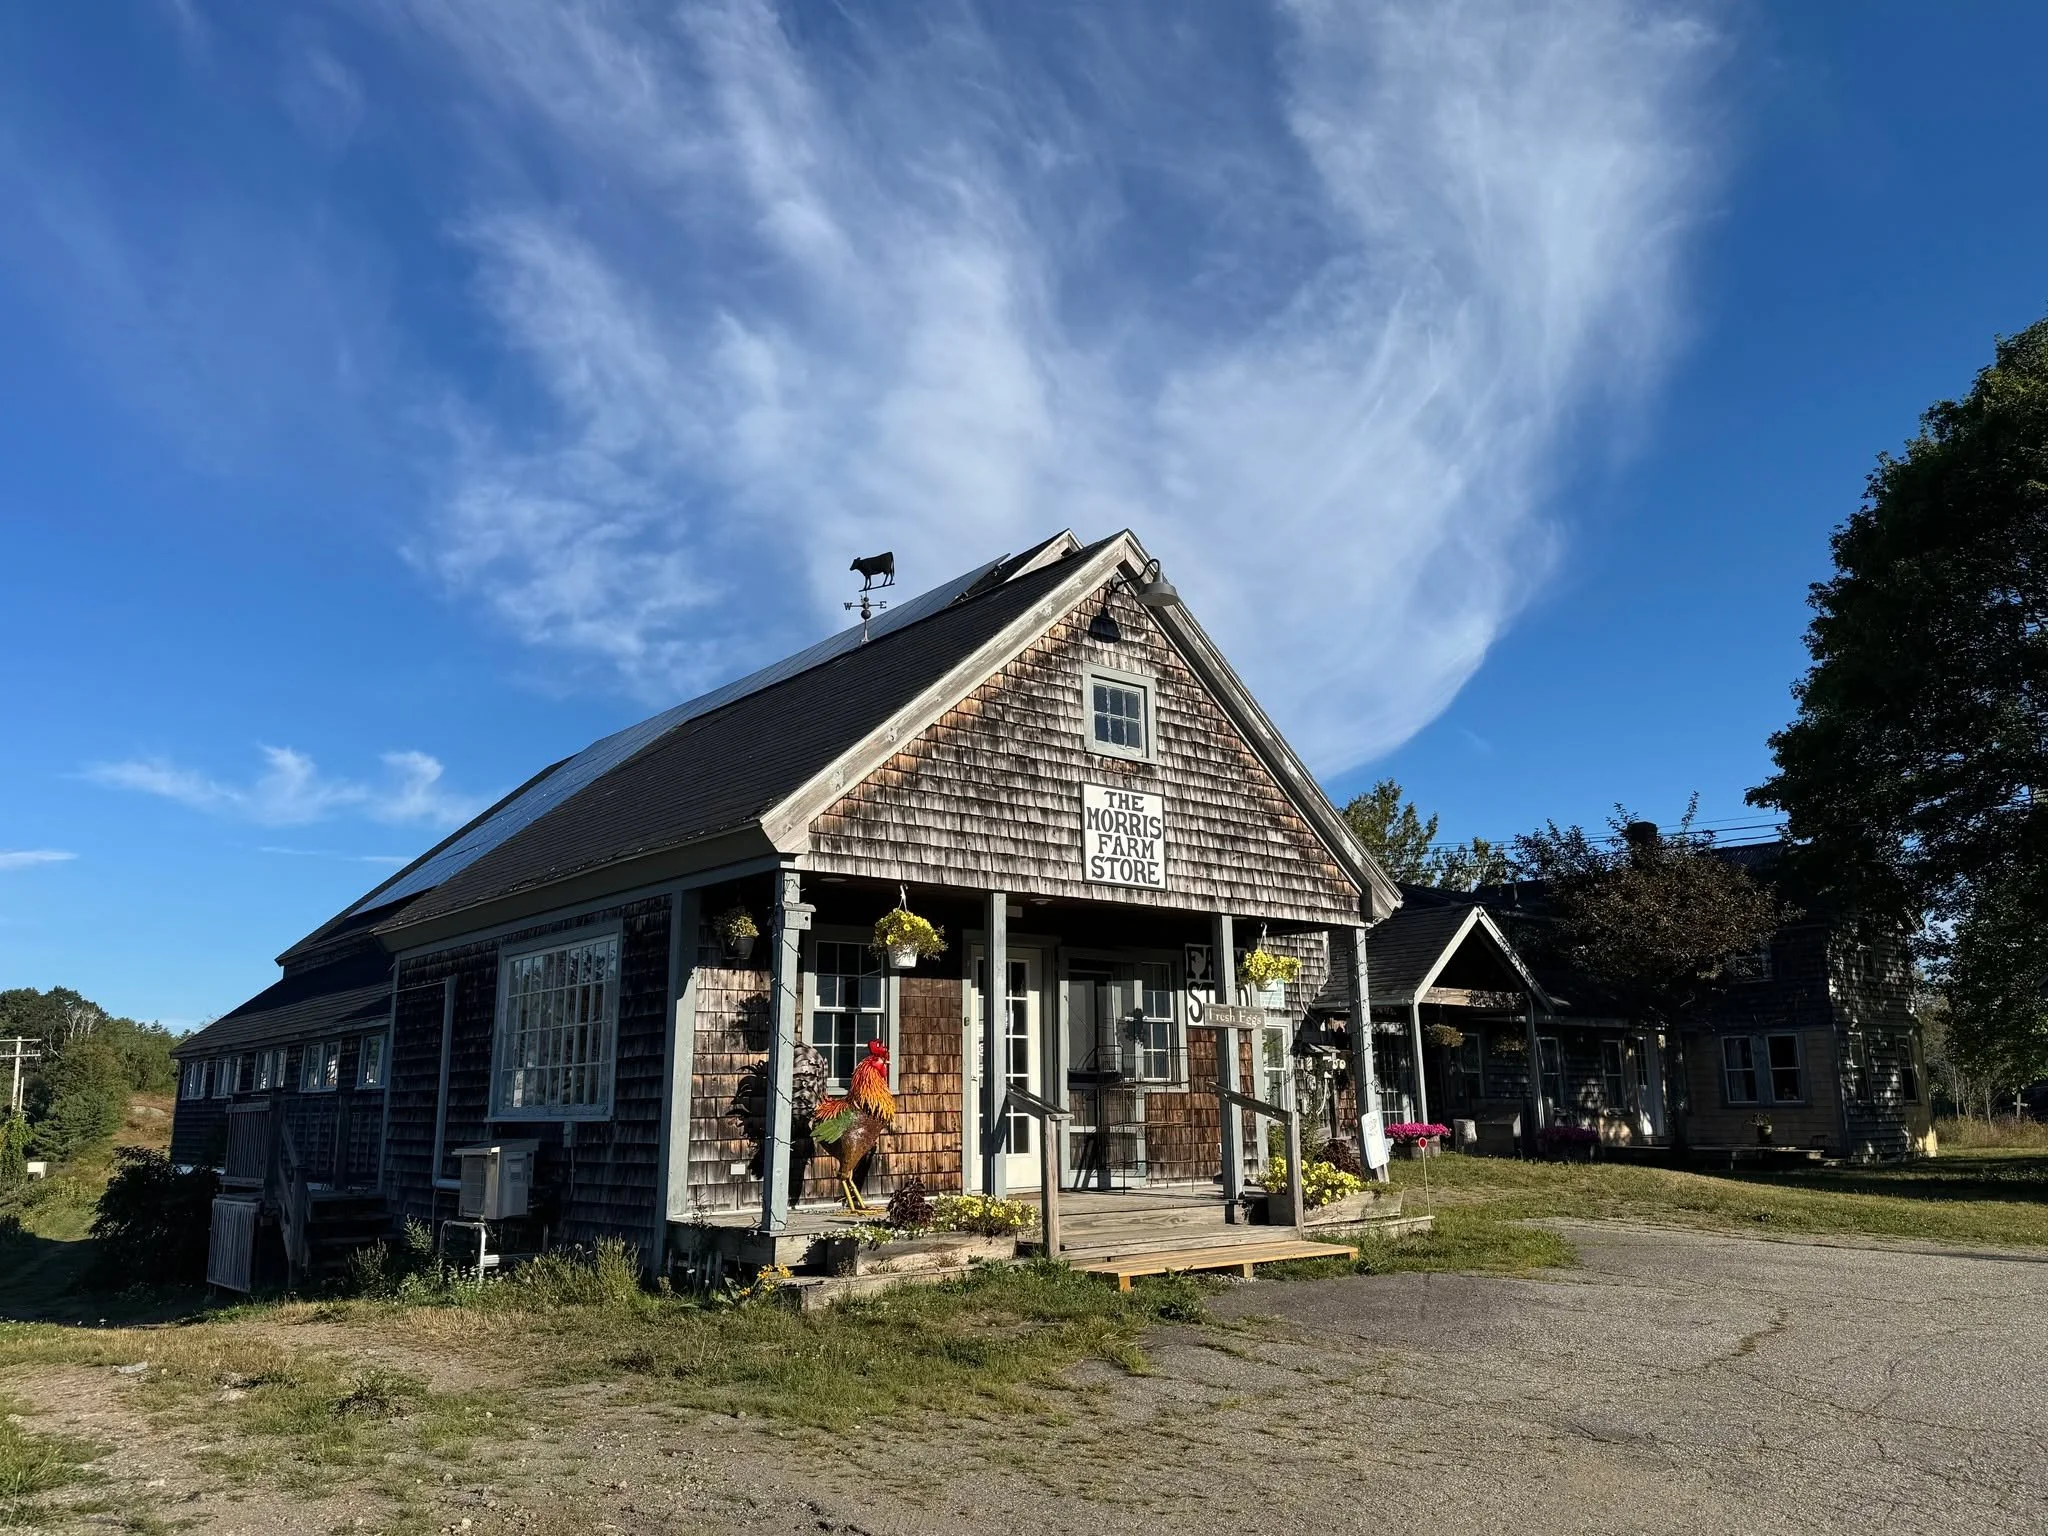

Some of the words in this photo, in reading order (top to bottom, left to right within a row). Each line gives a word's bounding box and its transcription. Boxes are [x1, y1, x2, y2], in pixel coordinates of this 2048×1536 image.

[879, 601, 887, 609] E
[1104, 791, 1144, 812] THE
[1086, 806, 1162, 840] MORRIS
[1098, 833, 1155, 860] FARM
[1091, 855, 1160, 885] STORE
[1209, 1007, 1236, 1023] Fresh
[1239, 1009, 1262, 1028] Eggs
